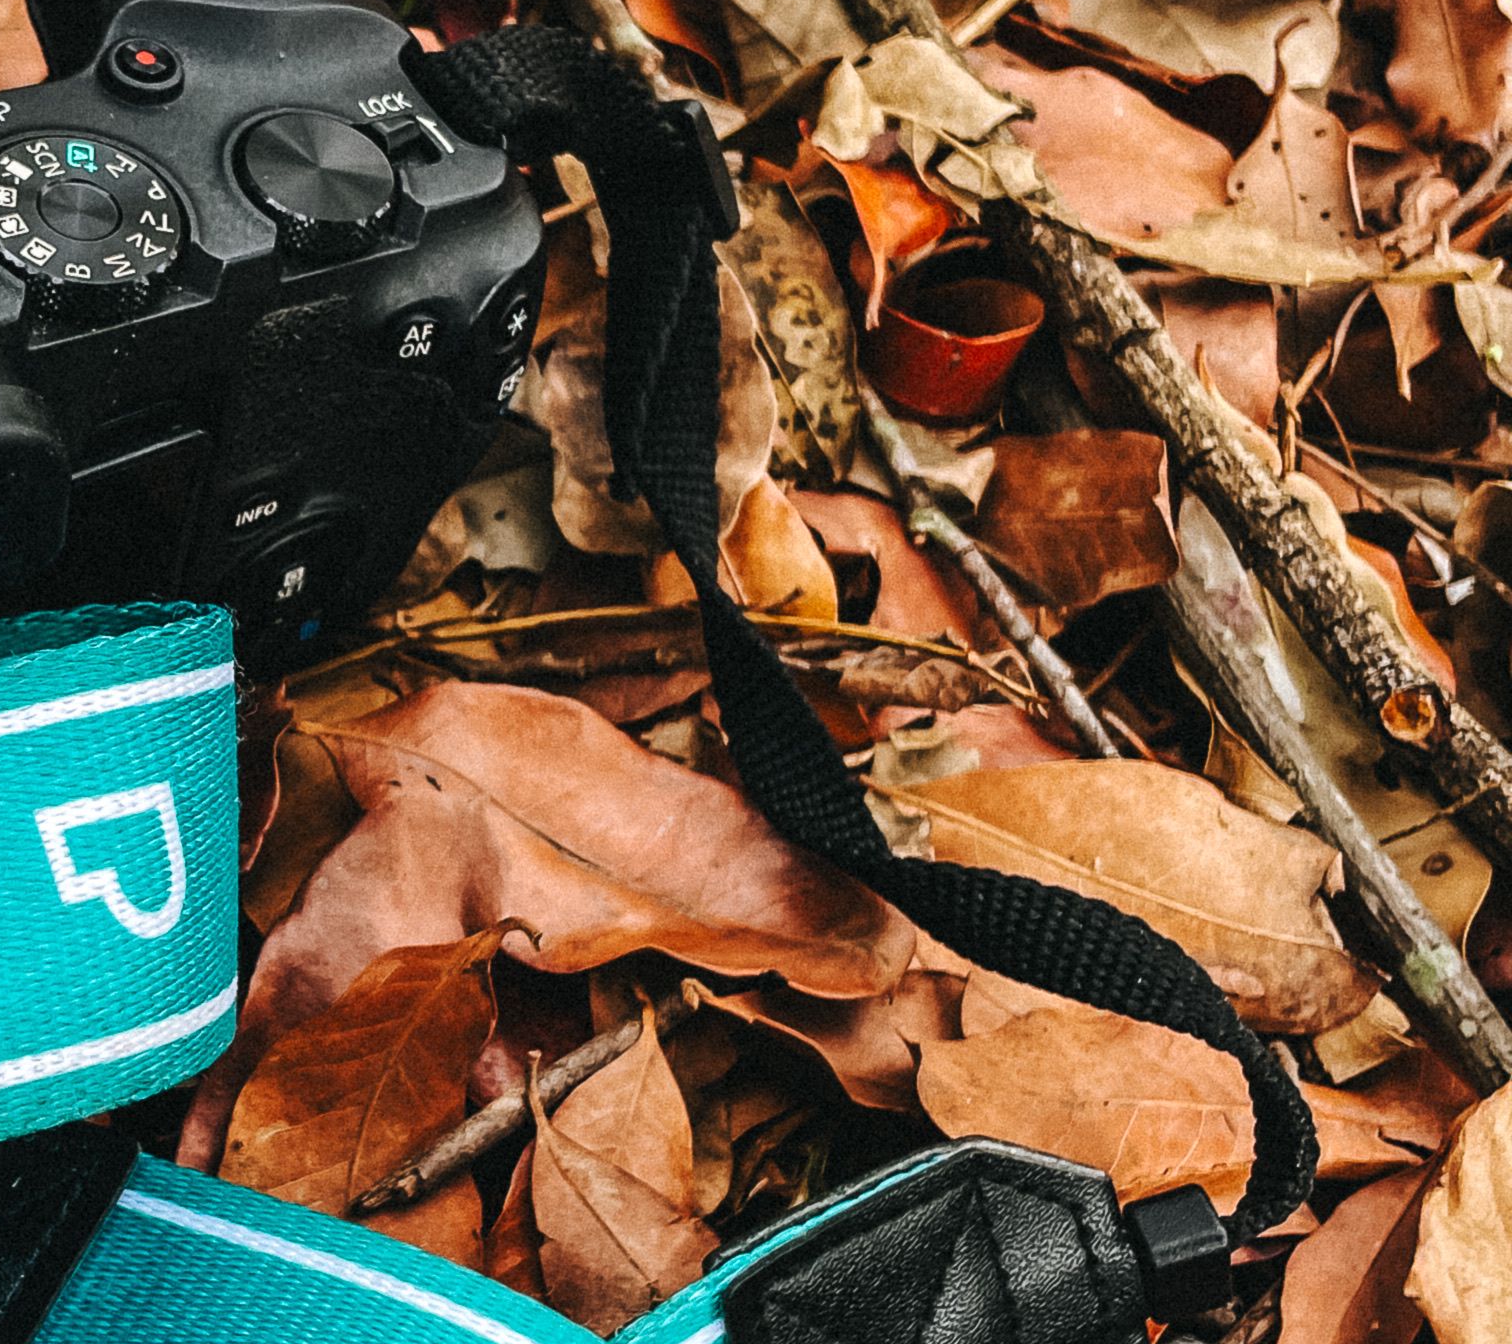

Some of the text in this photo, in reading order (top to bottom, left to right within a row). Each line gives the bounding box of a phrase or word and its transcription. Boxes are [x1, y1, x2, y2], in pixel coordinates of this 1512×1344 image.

[358, 91, 412, 118] LOCK
[26, 142, 66, 178] SCN
[105, 154, 138, 179] Fv
[147, 180, 167, 201] P
[140, 210, 175, 234] Tv
[27, 240, 55, 262] C1
[126, 233, 167, 258] Av
[65, 263, 91, 279] B
[103, 253, 136, 278] M
[404, 323, 434, 343] AF
[399, 341, 431, 358] ON
[235, 501, 278, 527] INFO
